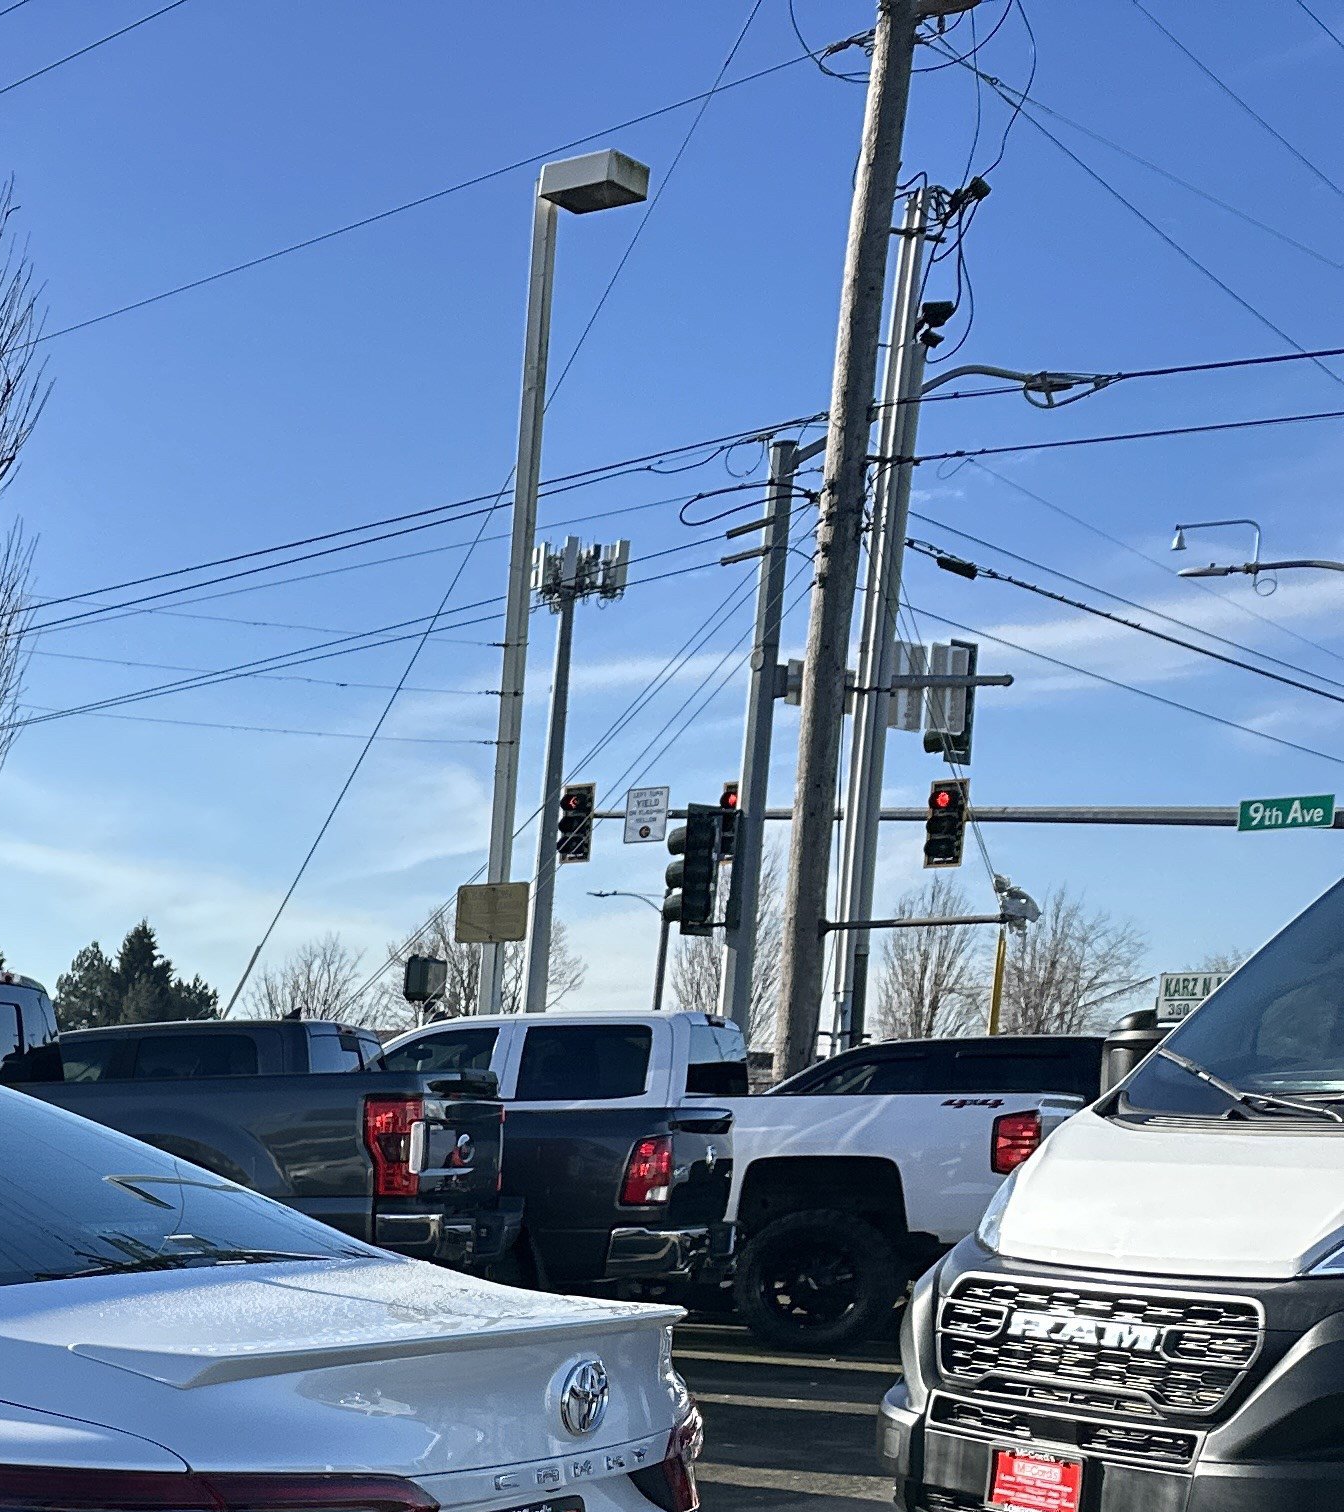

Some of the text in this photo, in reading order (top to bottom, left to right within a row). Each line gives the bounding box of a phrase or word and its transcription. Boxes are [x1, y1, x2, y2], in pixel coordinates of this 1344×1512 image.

[1250, 799, 1324, 826] 9th Ave
[1164, 976, 1199, 998] KARZ
[1007, 1311, 1162, 1351] RAM
[493, 1447, 649, 1491] CAMRY
